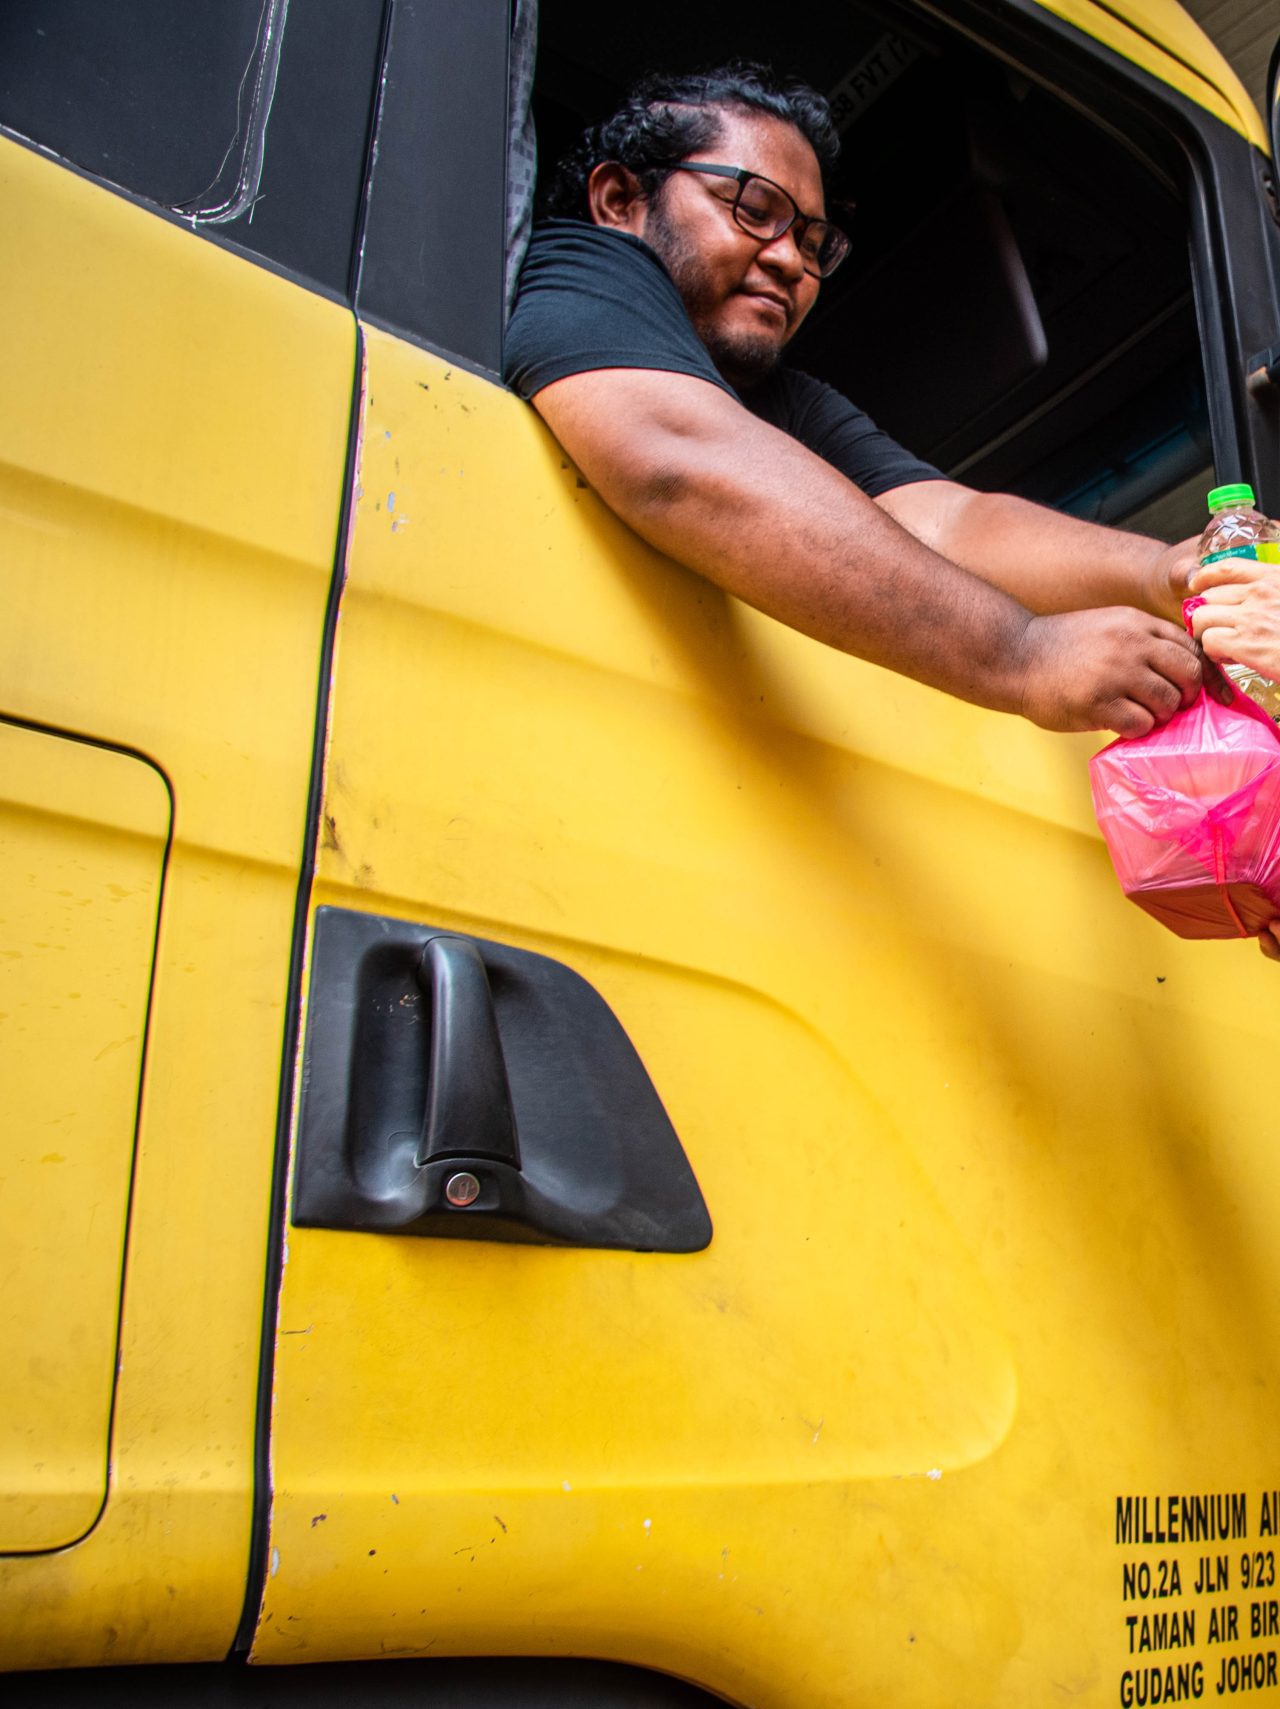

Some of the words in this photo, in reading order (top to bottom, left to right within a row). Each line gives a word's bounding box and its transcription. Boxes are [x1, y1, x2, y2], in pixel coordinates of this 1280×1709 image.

[1116, 1492, 1247, 1545] MILLENNIUM
[1123, 1559, 1182, 1601] NO.2A
[1194, 1555, 1229, 1594] JLN
[1240, 1550, 1275, 1590] 9/23
[1126, 1609, 1196, 1654] TAMAN
[1208, 1605, 1239, 1645] AIR
[1120, 1661, 1204, 1709] GUDANG
[1216, 1651, 1278, 1696] JOHOR
